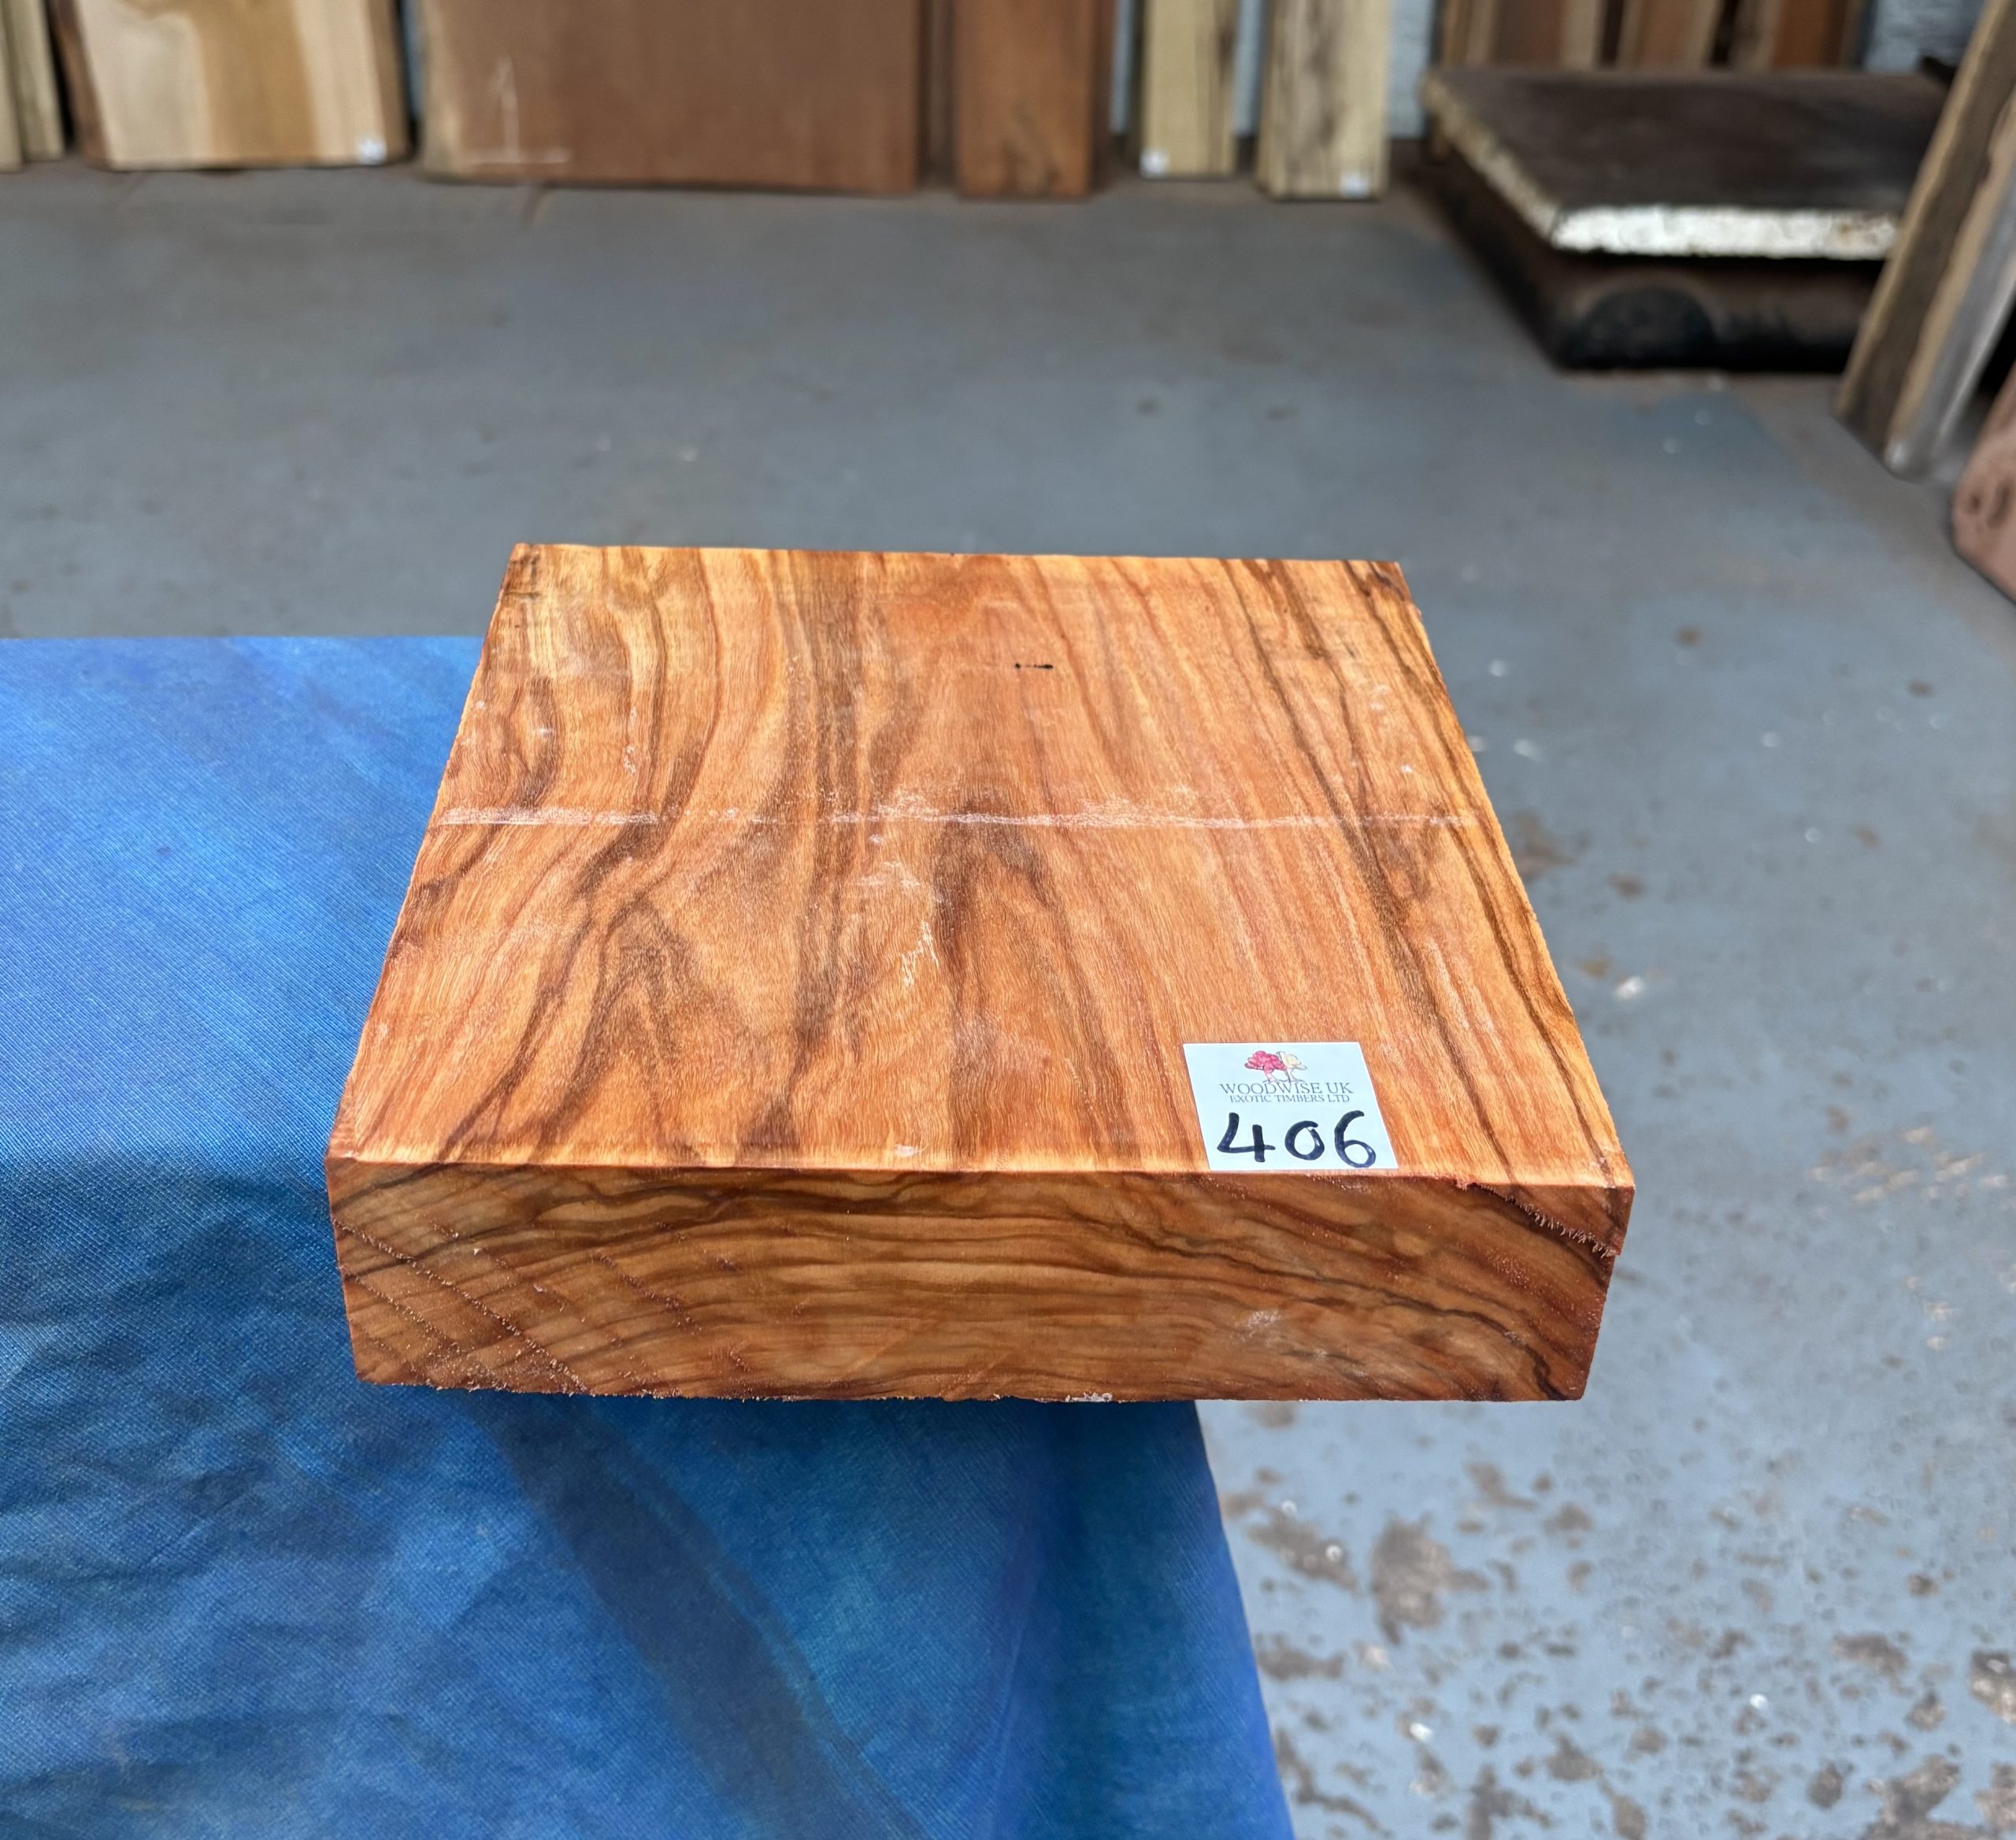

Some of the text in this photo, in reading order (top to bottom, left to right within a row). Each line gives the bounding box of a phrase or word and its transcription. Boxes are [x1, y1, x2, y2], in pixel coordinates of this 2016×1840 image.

[1220, 1082, 1354, 1094] WOODWISE UK
[1325, 1094, 1350, 1102] LTD
[1217, 1110, 1376, 1168] 406
